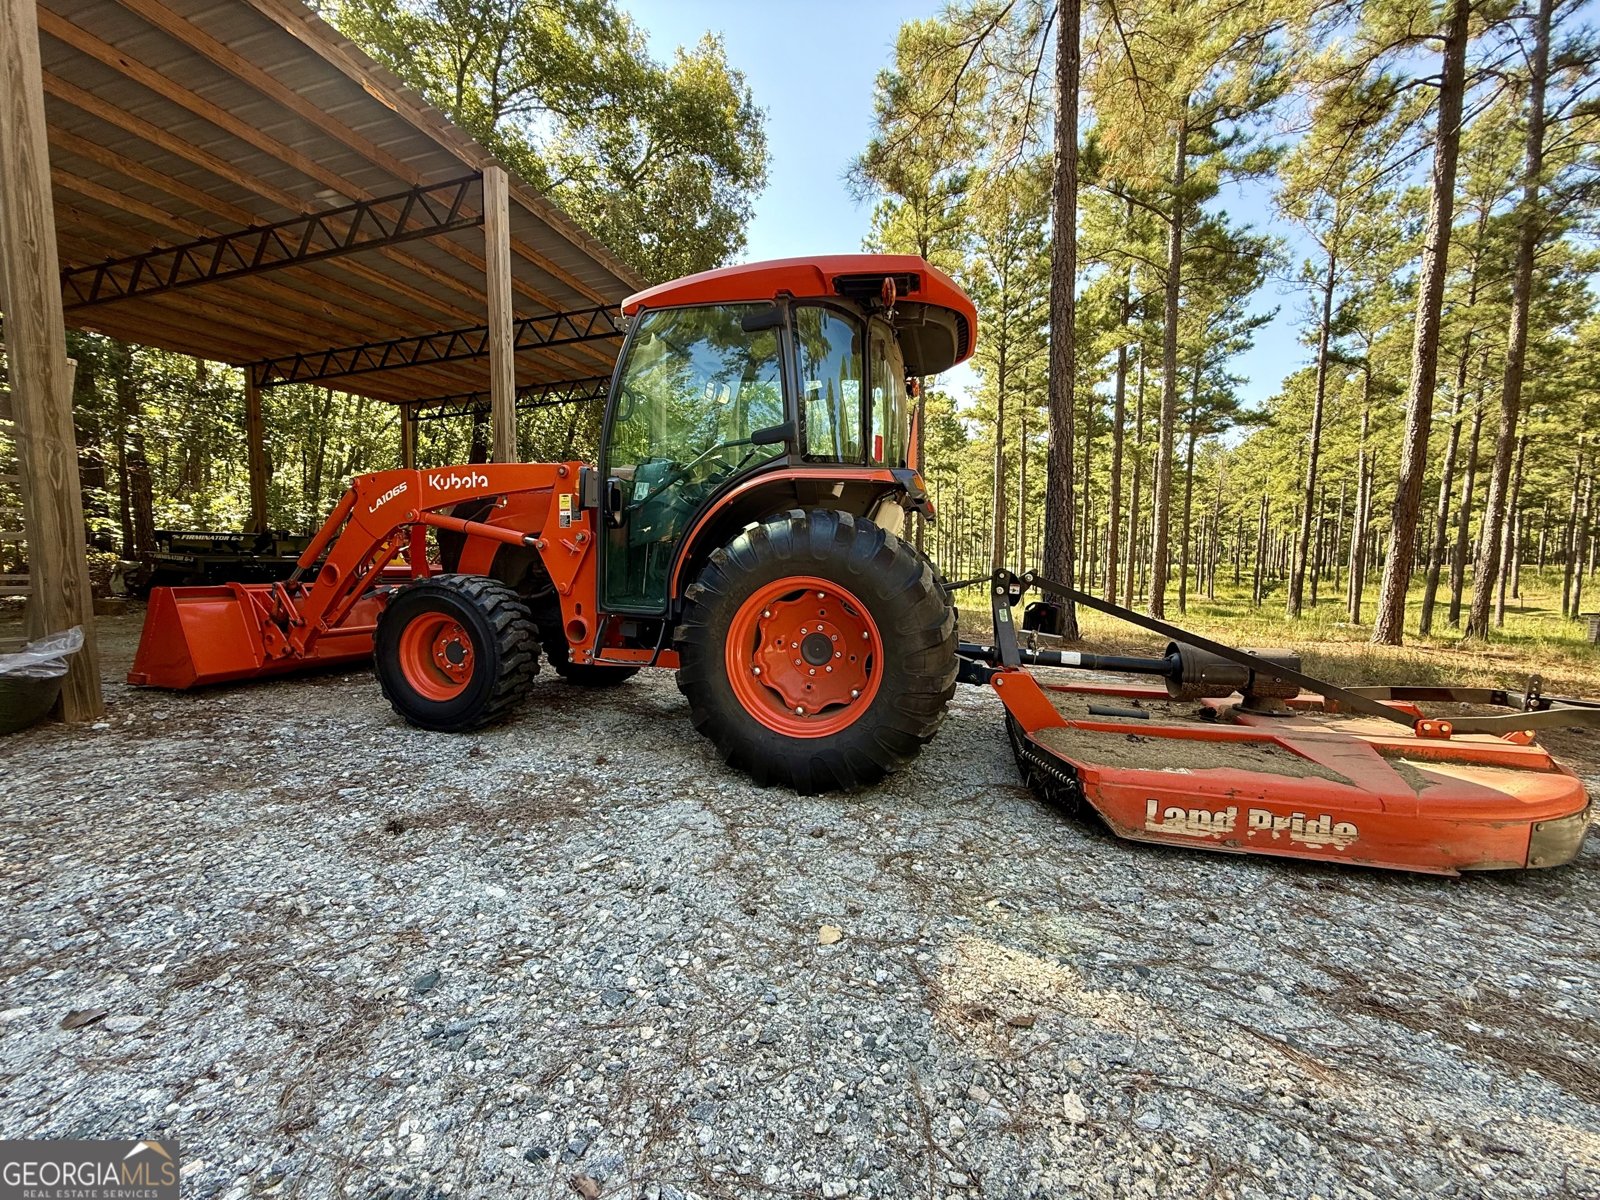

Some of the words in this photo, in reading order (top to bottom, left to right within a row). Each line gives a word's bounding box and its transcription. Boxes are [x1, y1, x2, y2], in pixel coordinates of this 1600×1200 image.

[368, 481, 408, 513] LA1065
[428, 471, 489, 491] Kubota
[1144, 798, 1238, 840] Land
[1247, 806, 1360, 851] Pride
